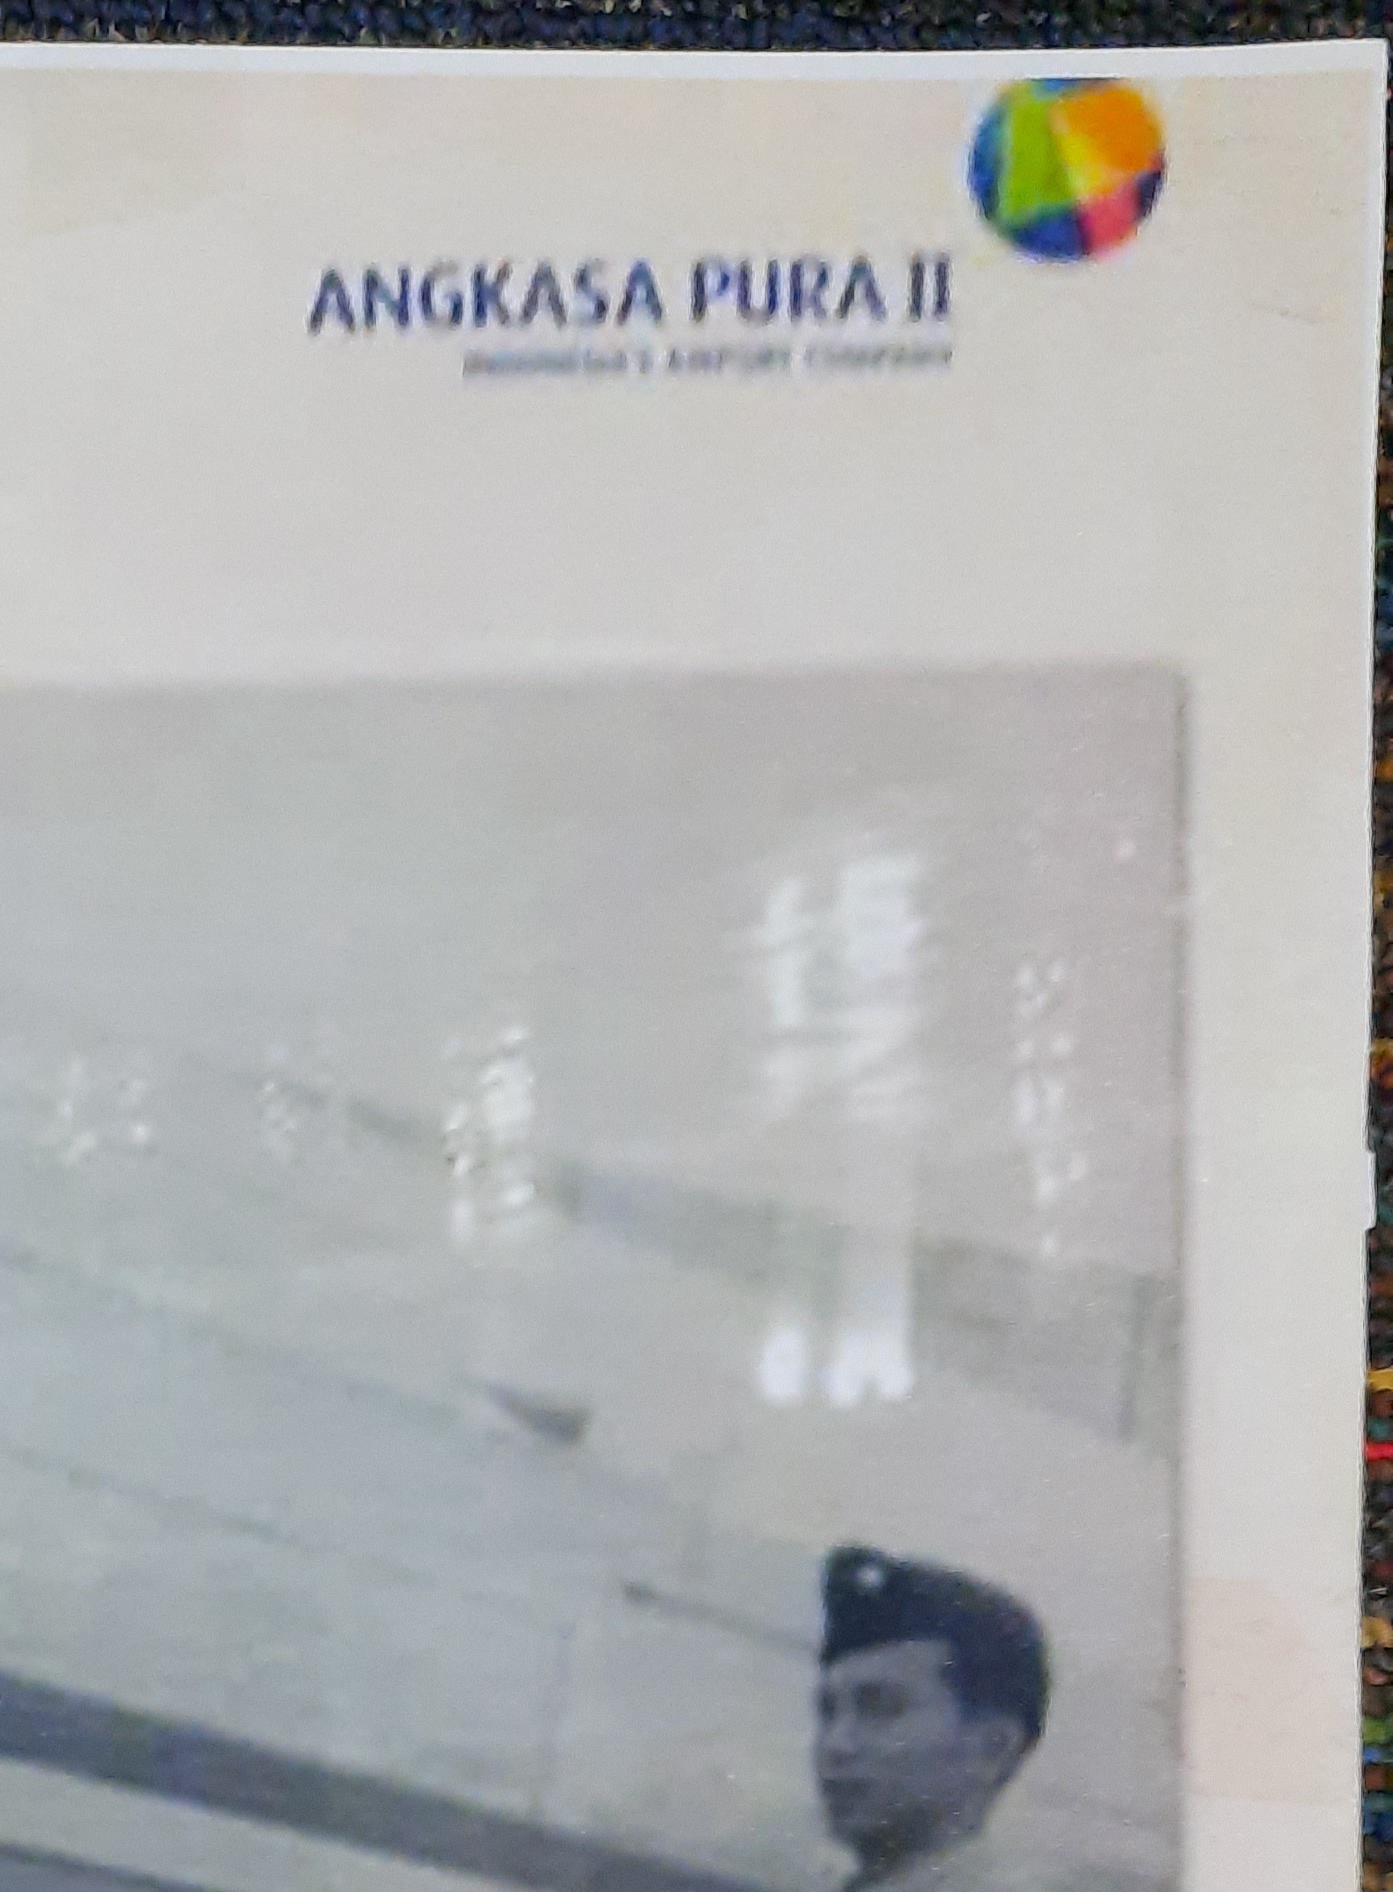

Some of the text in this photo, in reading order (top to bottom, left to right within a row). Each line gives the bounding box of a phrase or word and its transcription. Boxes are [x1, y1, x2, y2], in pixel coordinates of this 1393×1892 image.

[306, 250, 953, 338] ANGKASA PURA II
